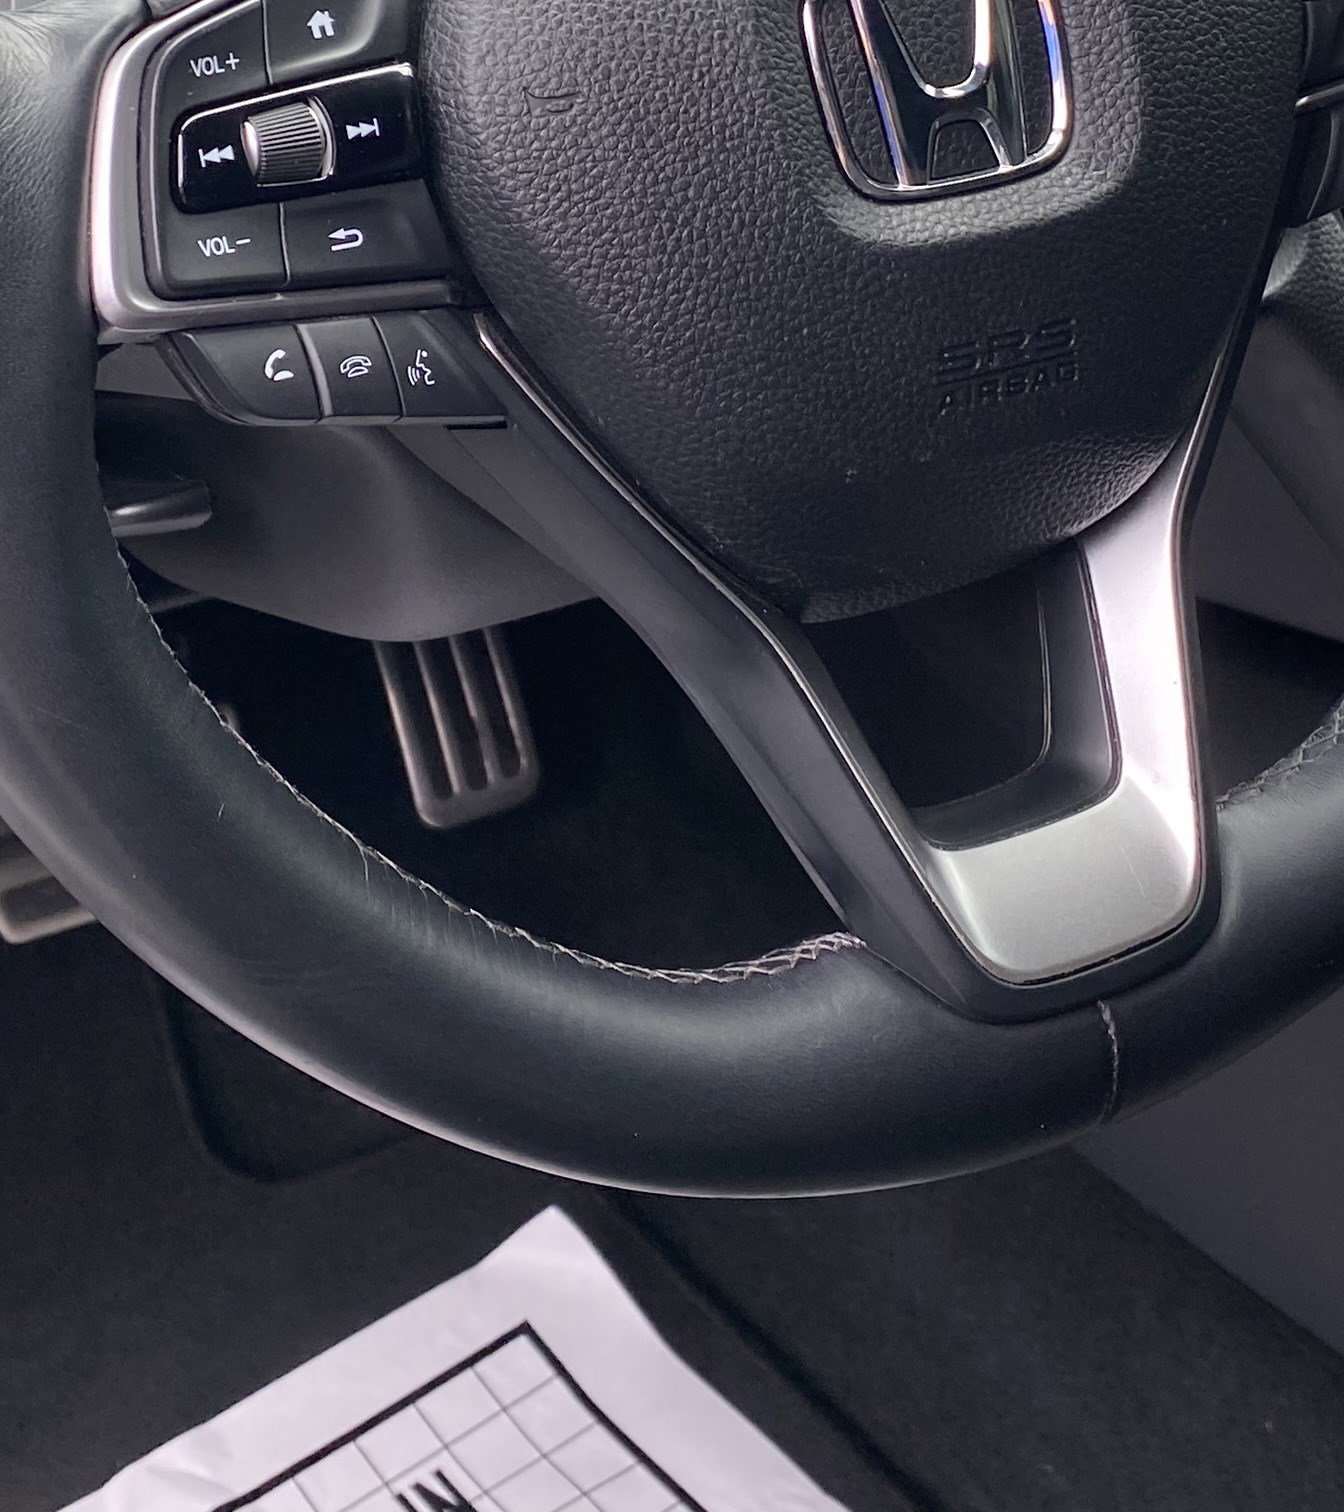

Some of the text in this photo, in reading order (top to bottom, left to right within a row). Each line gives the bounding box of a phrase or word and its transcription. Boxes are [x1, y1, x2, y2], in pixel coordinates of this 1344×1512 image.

[189, 52, 240, 78] VOL+
[197, 236, 251, 257] VOL-
[935, 316, 1080, 381] SRS
